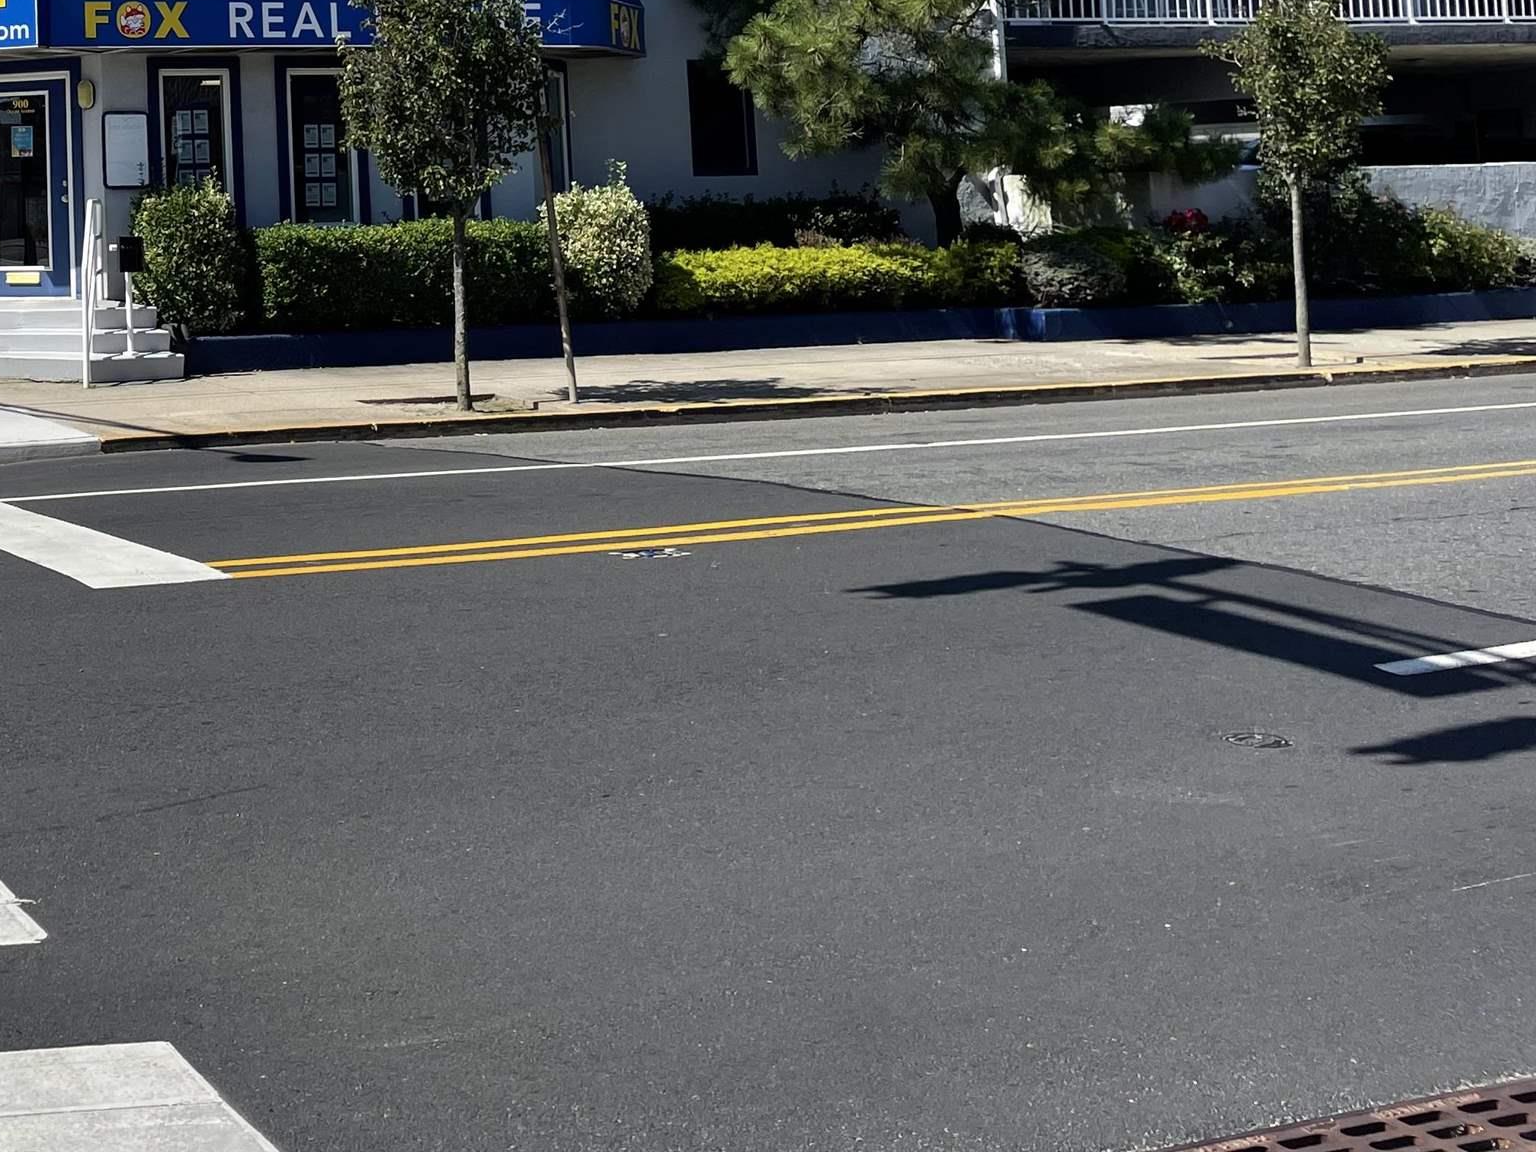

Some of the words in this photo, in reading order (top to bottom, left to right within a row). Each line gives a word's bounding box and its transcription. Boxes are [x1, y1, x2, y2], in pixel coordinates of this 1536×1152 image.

[84, 0, 190, 39] FOX
[228, 1, 352, 39] REAL
[610, 2, 641, 50] FOX
[12, 99, 29, 109] 900
